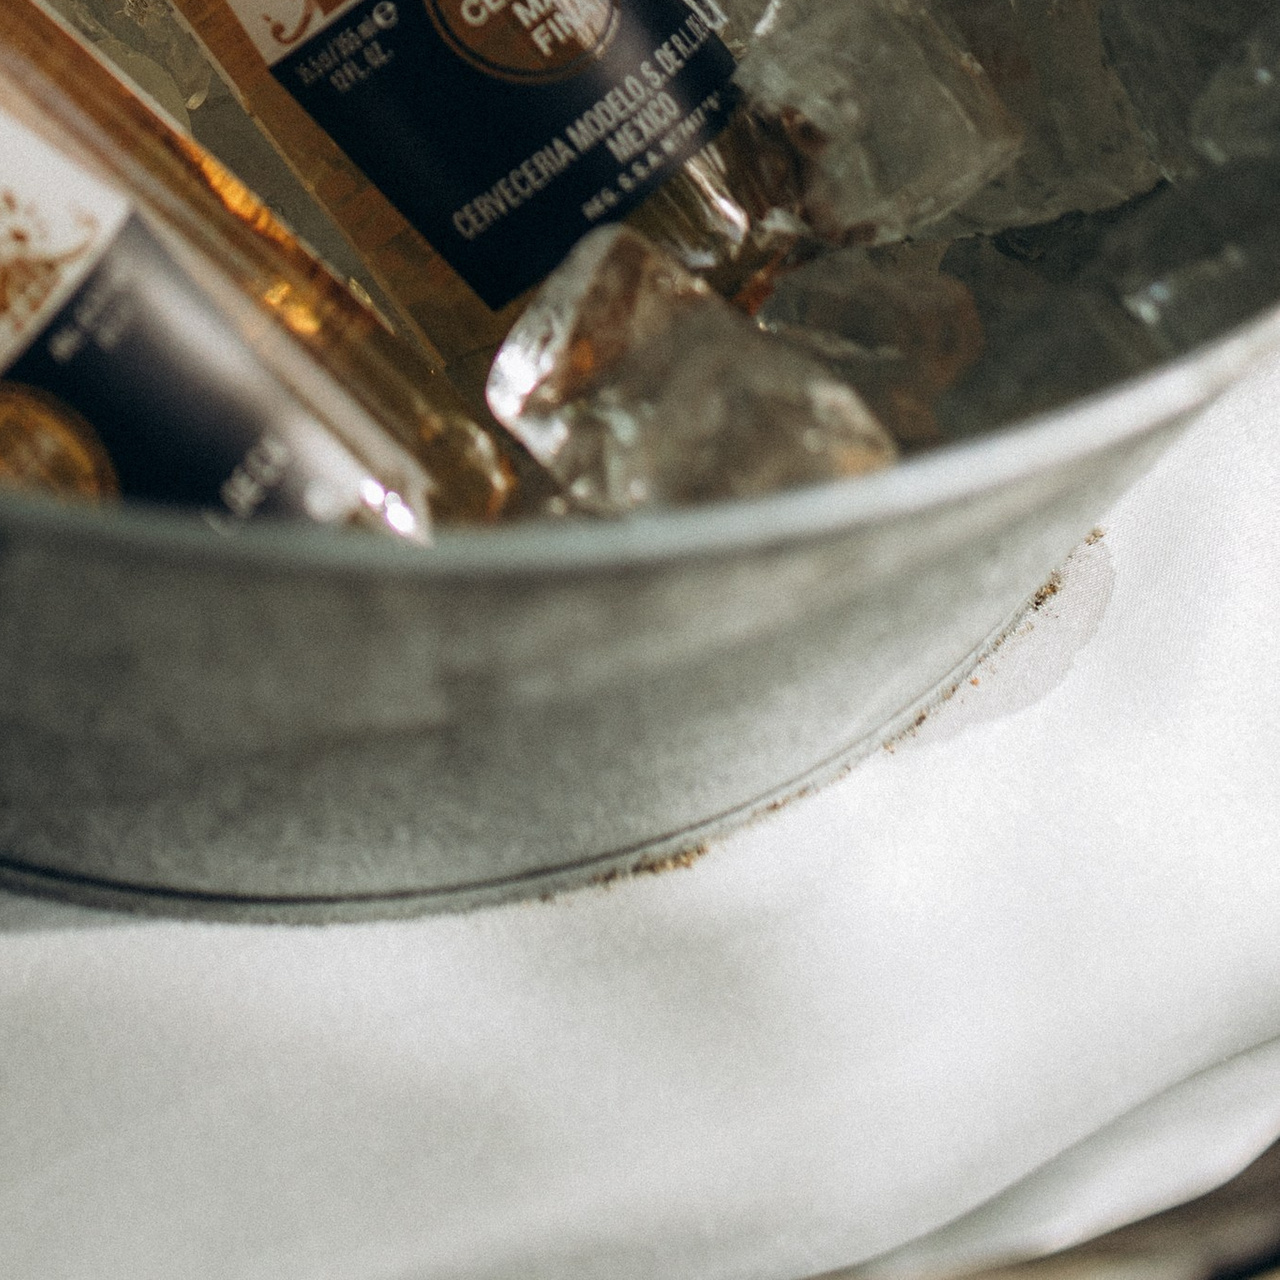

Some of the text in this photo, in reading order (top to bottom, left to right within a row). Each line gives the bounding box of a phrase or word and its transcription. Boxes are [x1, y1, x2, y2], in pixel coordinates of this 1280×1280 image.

[640, 60, 669, 90] S.
[654, 41, 686, 77] DE
[566, 74, 653, 154] MODELO,
[606, 90, 682, 163] MEXICO
[452, 137, 578, 239] CERVECERIA
